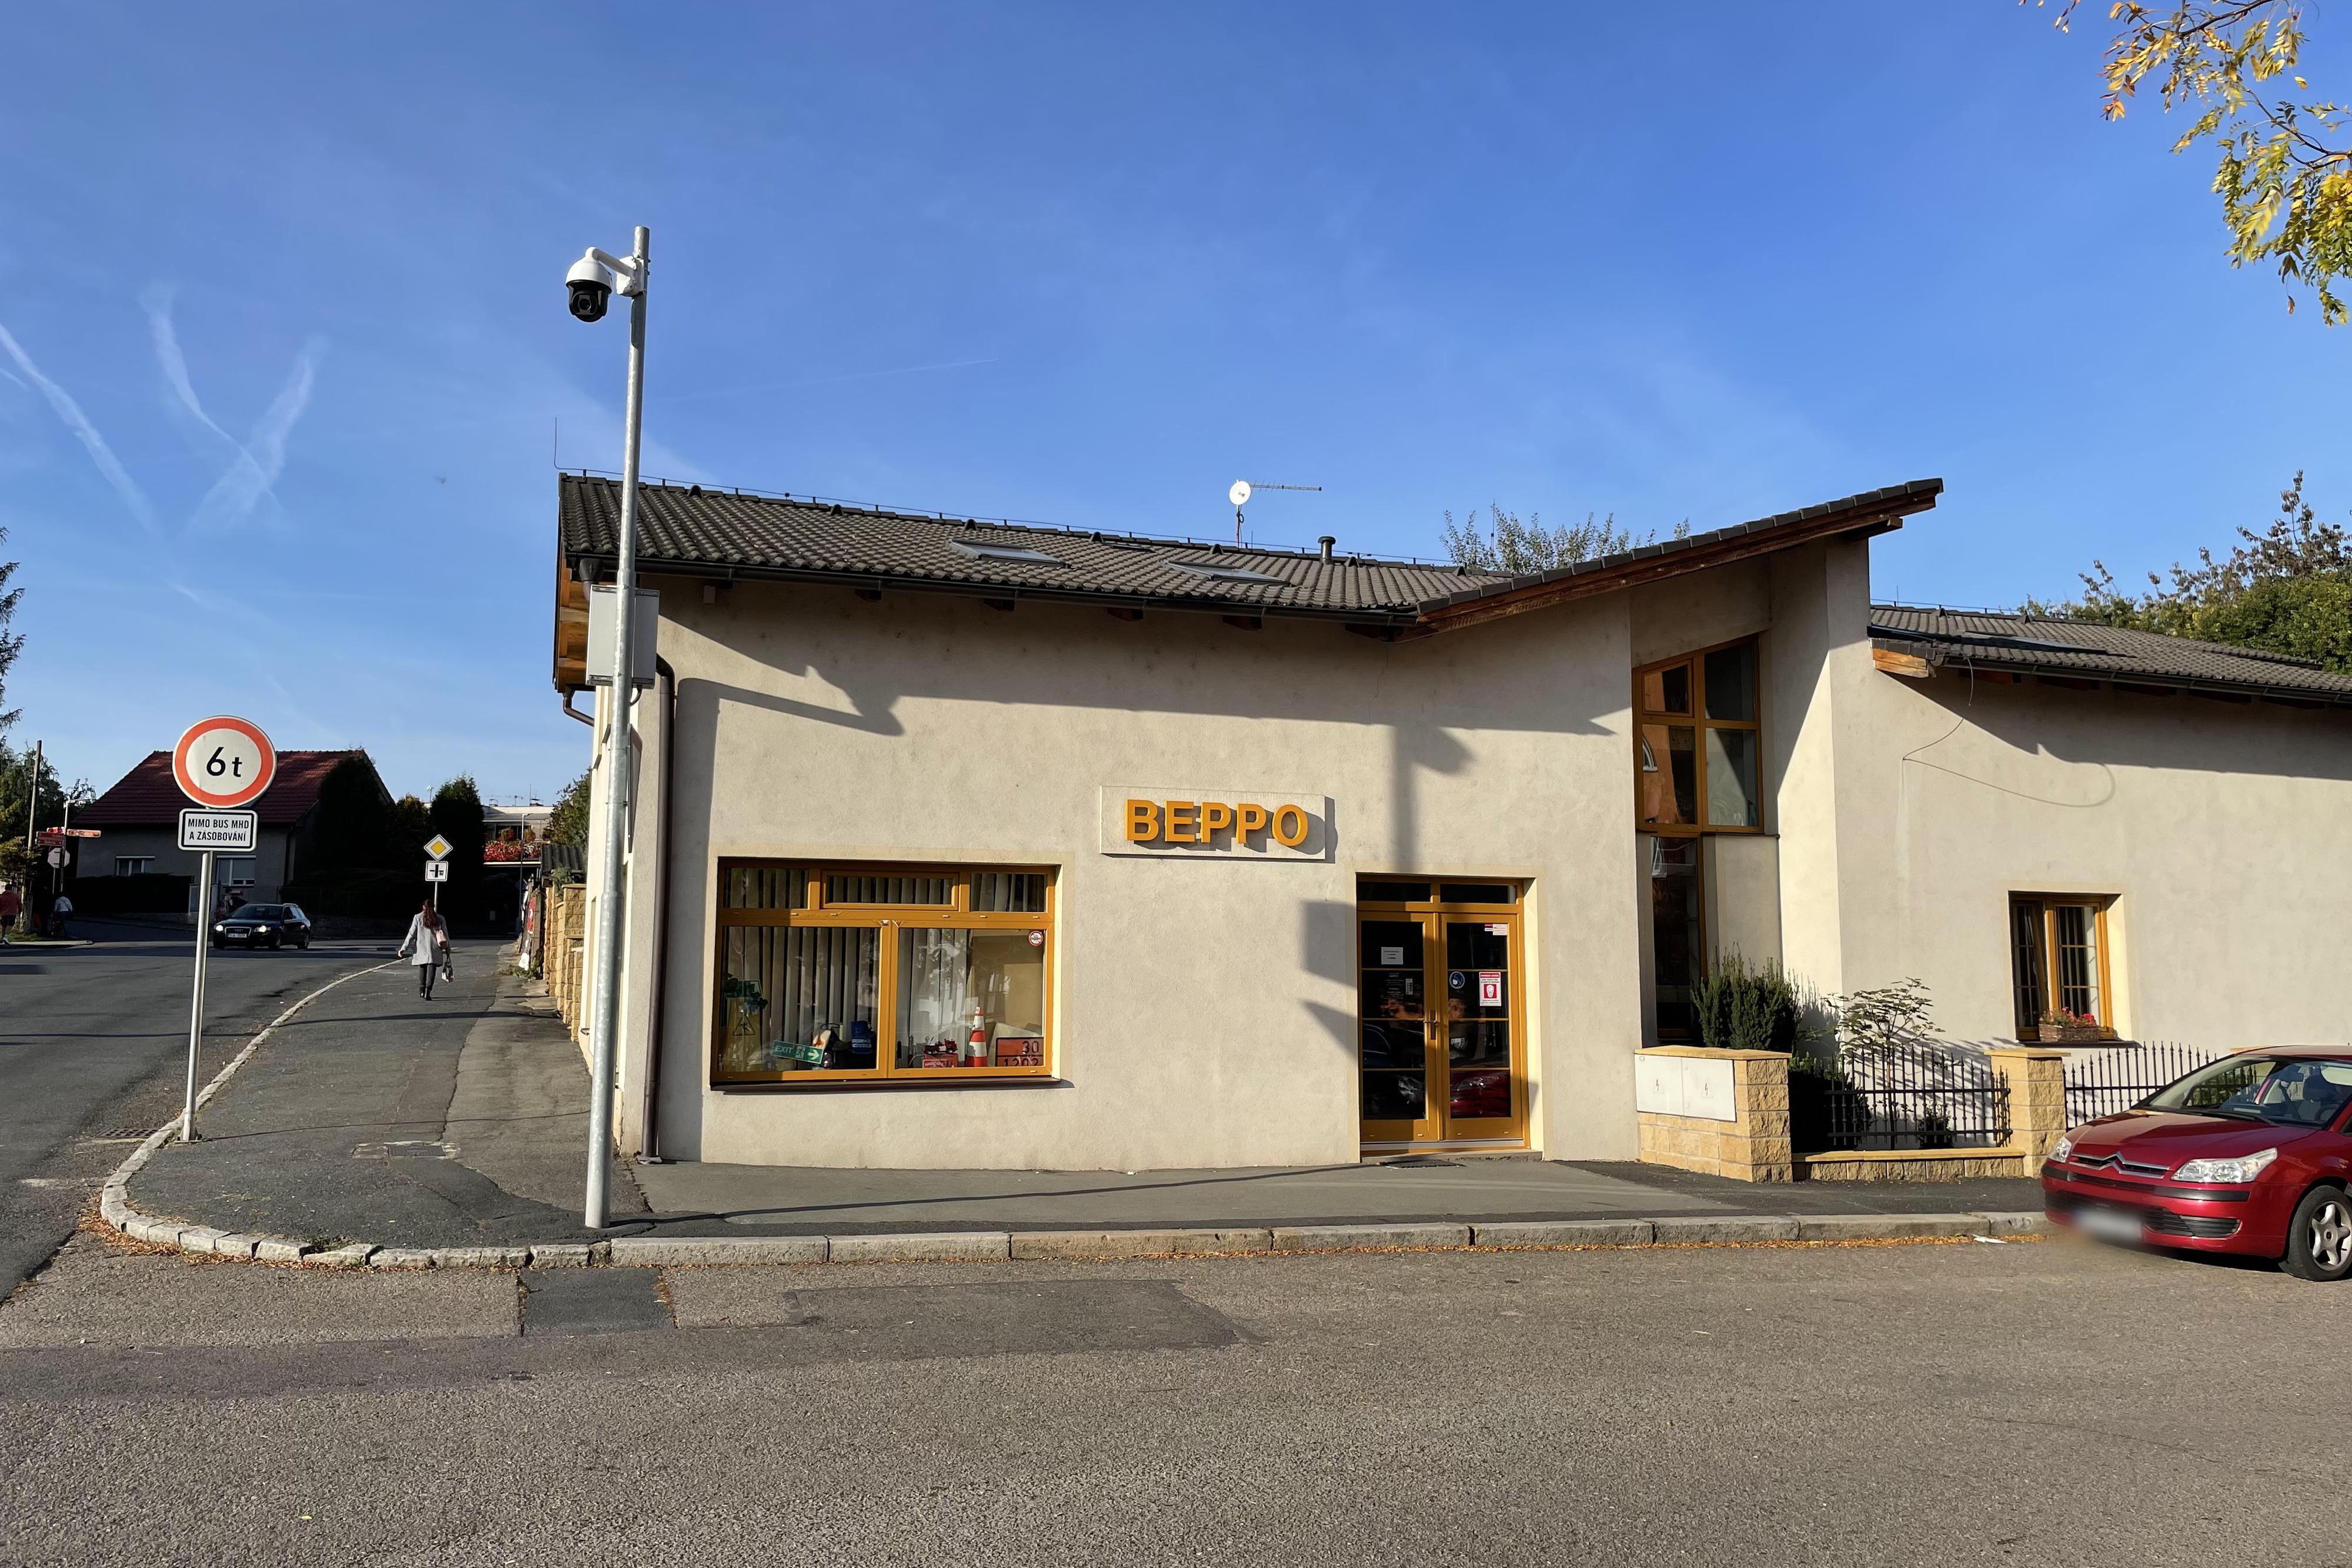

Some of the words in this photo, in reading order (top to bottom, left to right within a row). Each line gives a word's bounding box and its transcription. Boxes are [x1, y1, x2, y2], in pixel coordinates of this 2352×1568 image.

[188, 818, 210, 827] MIMO
[213, 819, 229, 828] BUS
[232, 820, 249, 829] MHD
[1125, 799, 1308, 846] BEPPO
[189, 831, 195, 840] A
[197, 830, 247, 841] ZÁSOBOVÁNÍ
[776, 1045, 793, 1054] EXIT
[1023, 1041, 1039, 1054] 30
